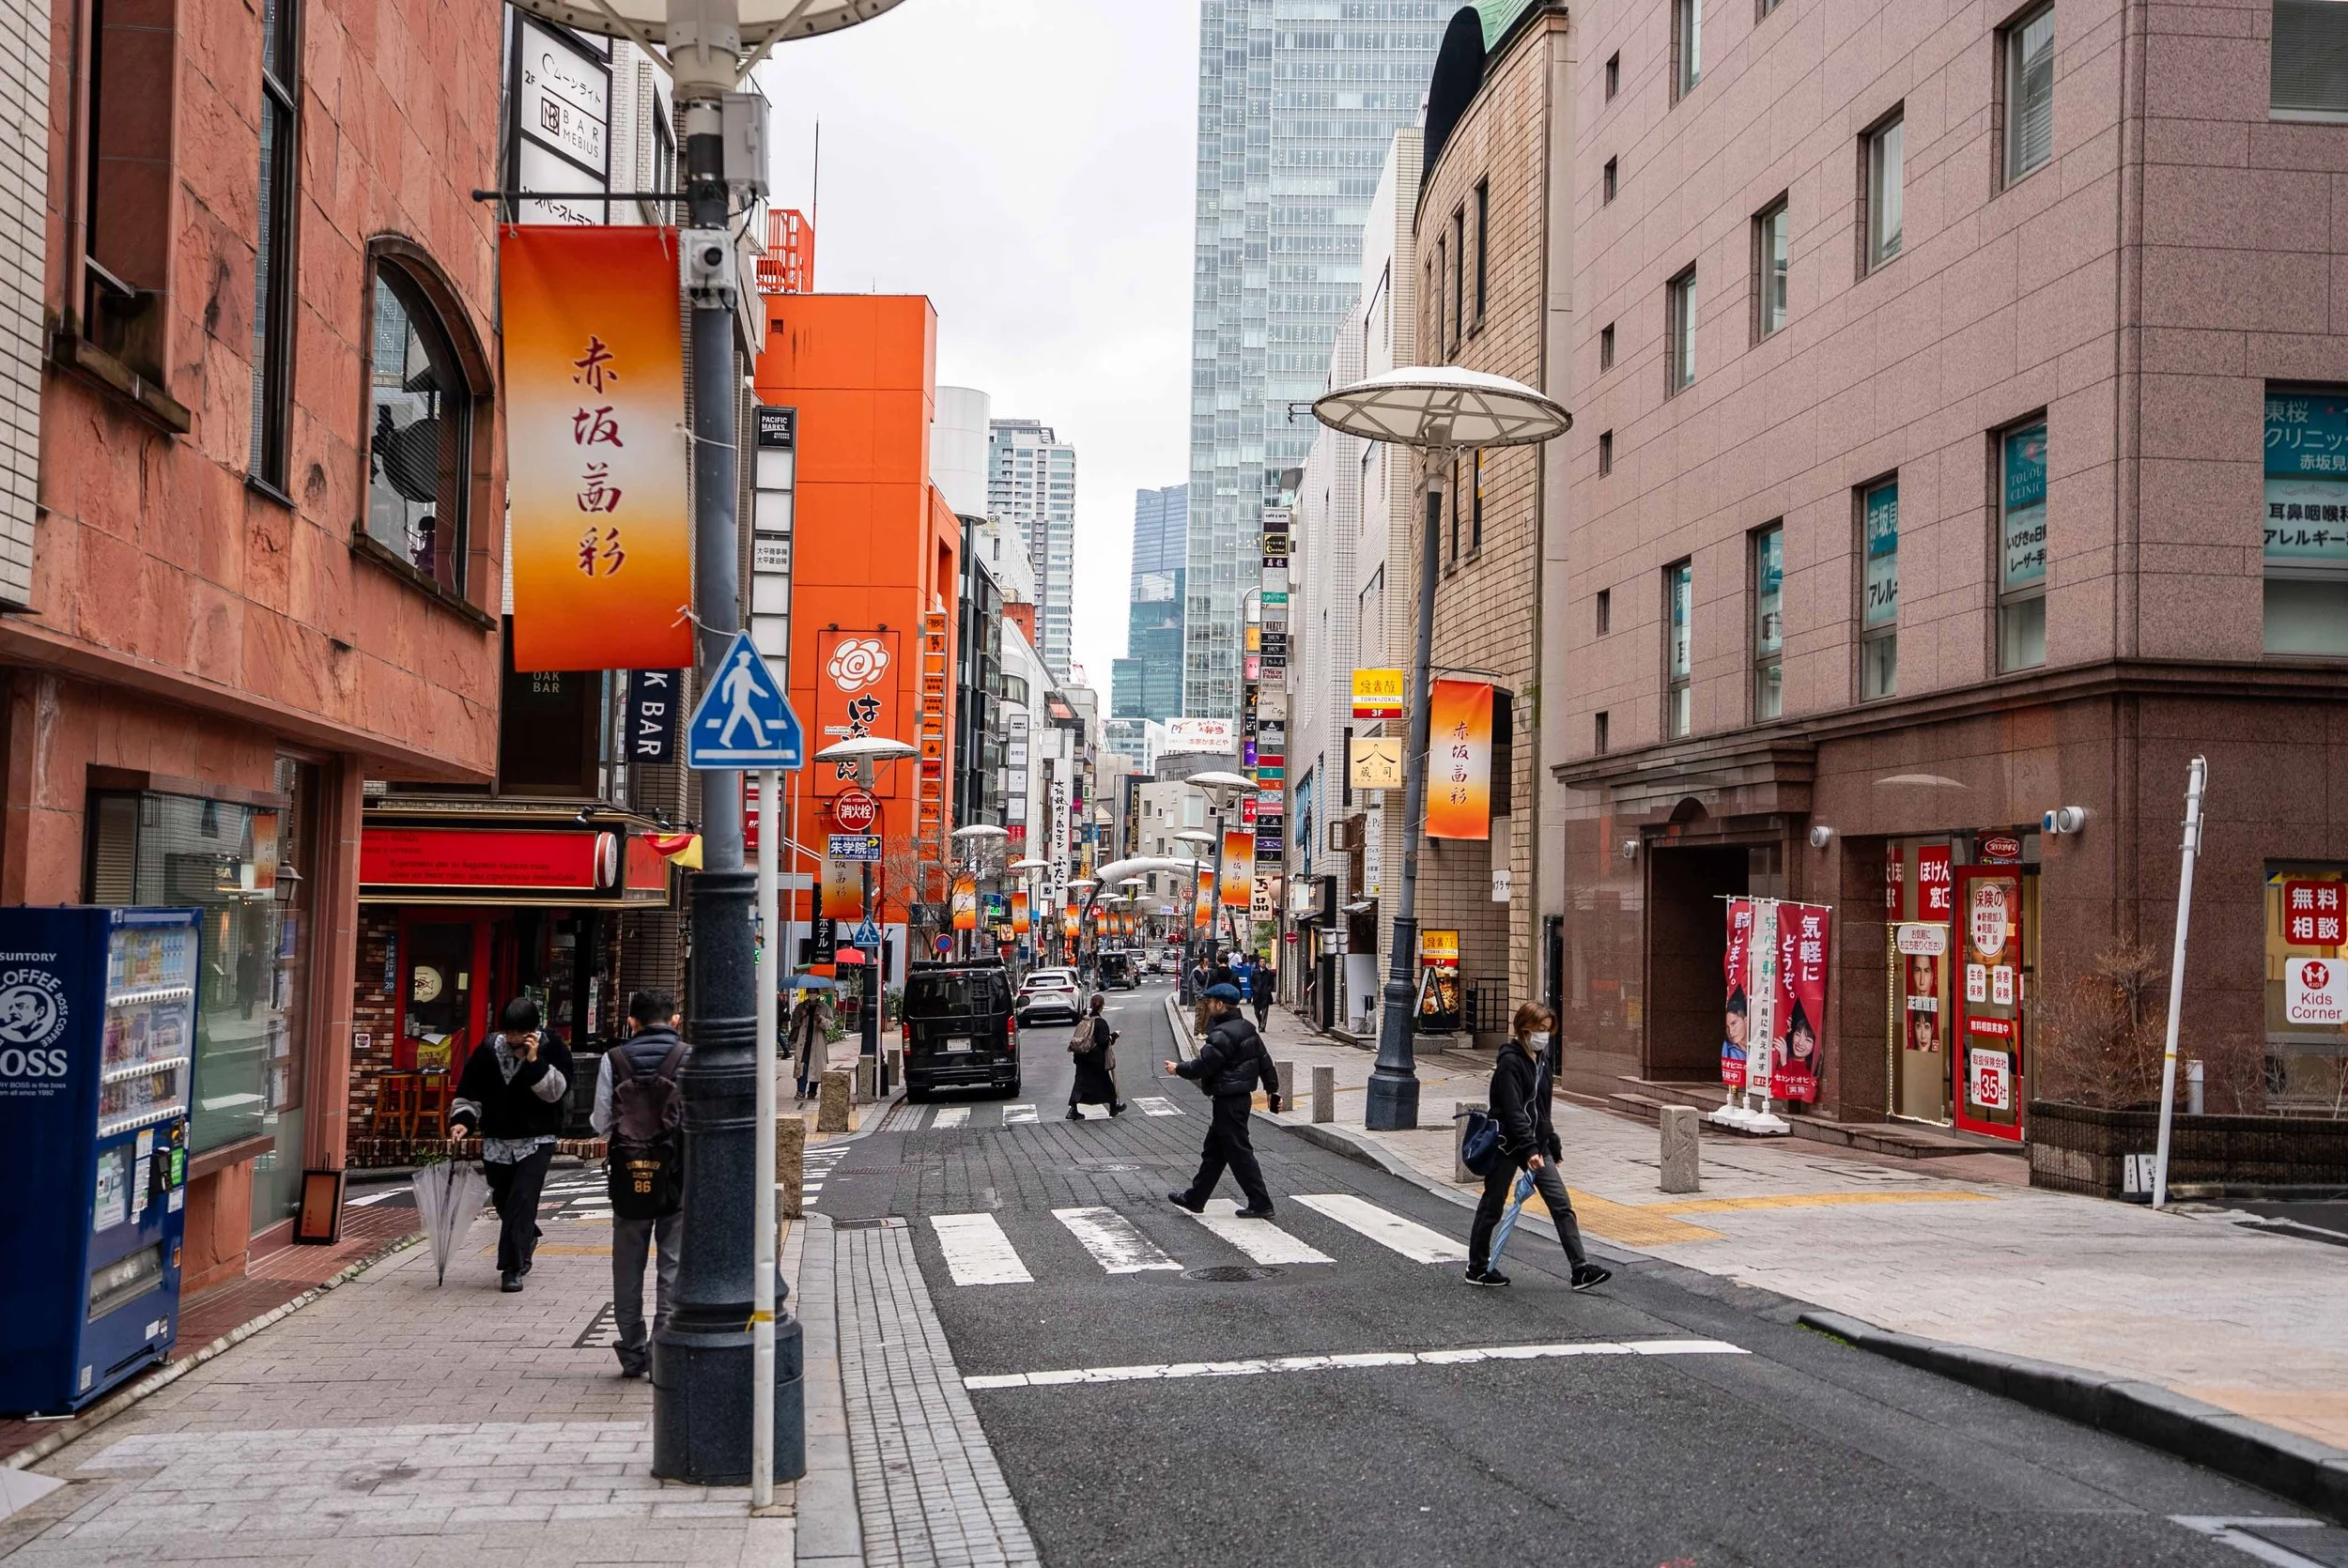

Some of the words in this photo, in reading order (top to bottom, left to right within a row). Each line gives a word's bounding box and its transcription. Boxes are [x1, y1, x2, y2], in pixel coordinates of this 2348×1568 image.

[525, 70, 536, 85] 2F
[554, 68, 601, 103] ムーンライト
[564, 110, 599, 141] BAR
[564, 129, 599, 158] MEBIUS
[762, 416, 788, 424] PACIFIC
[2264, 400, 2309, 423] 東桜
[2264, 427, 2348, 451] クリニッ
[573, 335, 626, 576] 赤坂茜彩
[2300, 454, 2348, 470] 赤坂見
[2011, 482, 2043, 501] CLINIC
[533, 671, 560, 682] OAK
[533, 683, 560, 693] BAR
[637, 701, 665, 756] BAR
[1450, 720, 1469, 805] 赤坂茜彩
[841, 805, 872, 819] 消火栓
[830, 841, 868, 854] 朱学院
[835, 860, 847, 898] 坂茜彩
[1920, 860, 1950, 882] ほけん
[1976, 890, 2003, 908] 保険の
[2292, 887, 2339, 911] 無料
[1982, 913, 2003, 923] 新規加入
[1911, 930, 1930, 939] お気軽に
[1982, 925, 1998, 934] 見直し
[2293, 917, 2339, 939] 相談
[1800, 915, 1822, 981] 気軽に
[1900, 940, 1944, 951] お立ち寄りください
[1783, 934, 1797, 998] どうぞ。
[0, 968, 62, 993] OFFEE
[1970, 969, 1983, 981] 生命
[1995, 971, 2010, 984] 損害
[385, 981, 394, 990] 20
[1970, 985, 1984, 998] 保険
[1995, 987, 2010, 1001] 保険
[54, 992, 68, 1016] BOSS
[2301, 992, 2333, 1005] Kids
[2292, 1007, 2343, 1019] Corner
[41, 1017, 68, 1048] COFFEE
[0, 1049, 68, 1078] OSS
[1972, 1053, 2007, 1069] 取扱保険会社
[634, 1180, 652, 1192] 86
